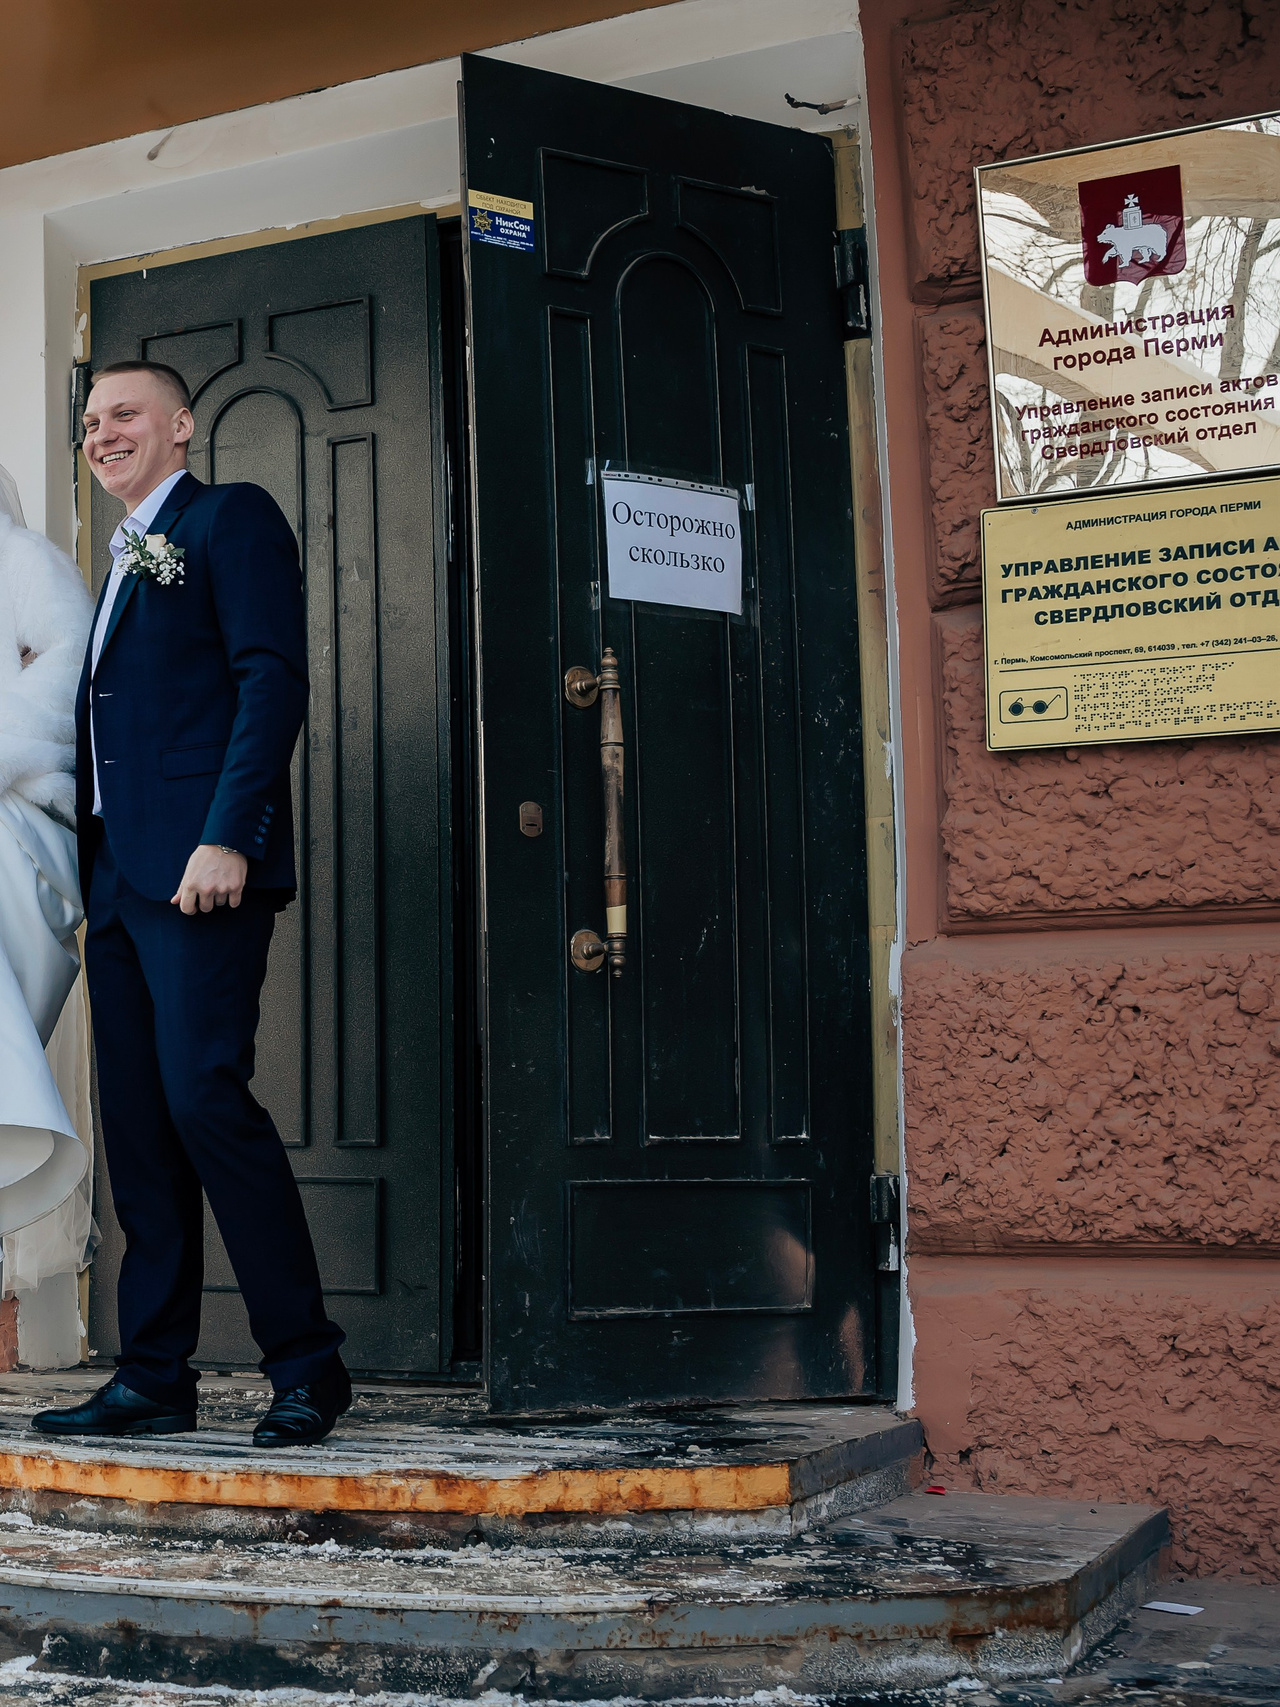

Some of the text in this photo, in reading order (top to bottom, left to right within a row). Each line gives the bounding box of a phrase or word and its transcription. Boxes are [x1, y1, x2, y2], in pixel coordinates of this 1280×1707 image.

[482, 202, 521, 215] ПОД ОХРАНОЙ
[496, 199, 527, 210] НАХОДИТСЯ
[499, 227, 527, 239] ОХРАНА
[1038, 303, 1235, 348] Администрация
[1053, 332, 1224, 371] города Перми
[1014, 373, 1279, 421] Управление записи актов
[1021, 397, 1275, 444] гражданского состояния
[1041, 421, 1257, 460] Свердловский отдел
[612, 501, 736, 540] Осторожно
[1066, 500, 1262, 530] АДМИНИСТРАЦИЯ ГОРОДА ПЕРМИ
[628, 545, 725, 573] скользко
[1000, 549, 1152, 578] УПРАВЛЕНИЕ
[1158, 538, 1255, 562] ЗАПИСИ
[1001, 562, 1280, 603] ГРАЖДАНСКОГО СОСТО
[1034, 591, 1222, 625] СВЕРДЛОВСКИЙ
[1000, 657, 1029, 666] Пермь,
[1030, 651, 1093, 662] Комсомольский
[1094, 647, 1133, 657] проспект,
[1181, 641, 1198, 650] тел.
[1200, 640, 1210, 648] +7
[1211, 638, 1232, 648] (342)
